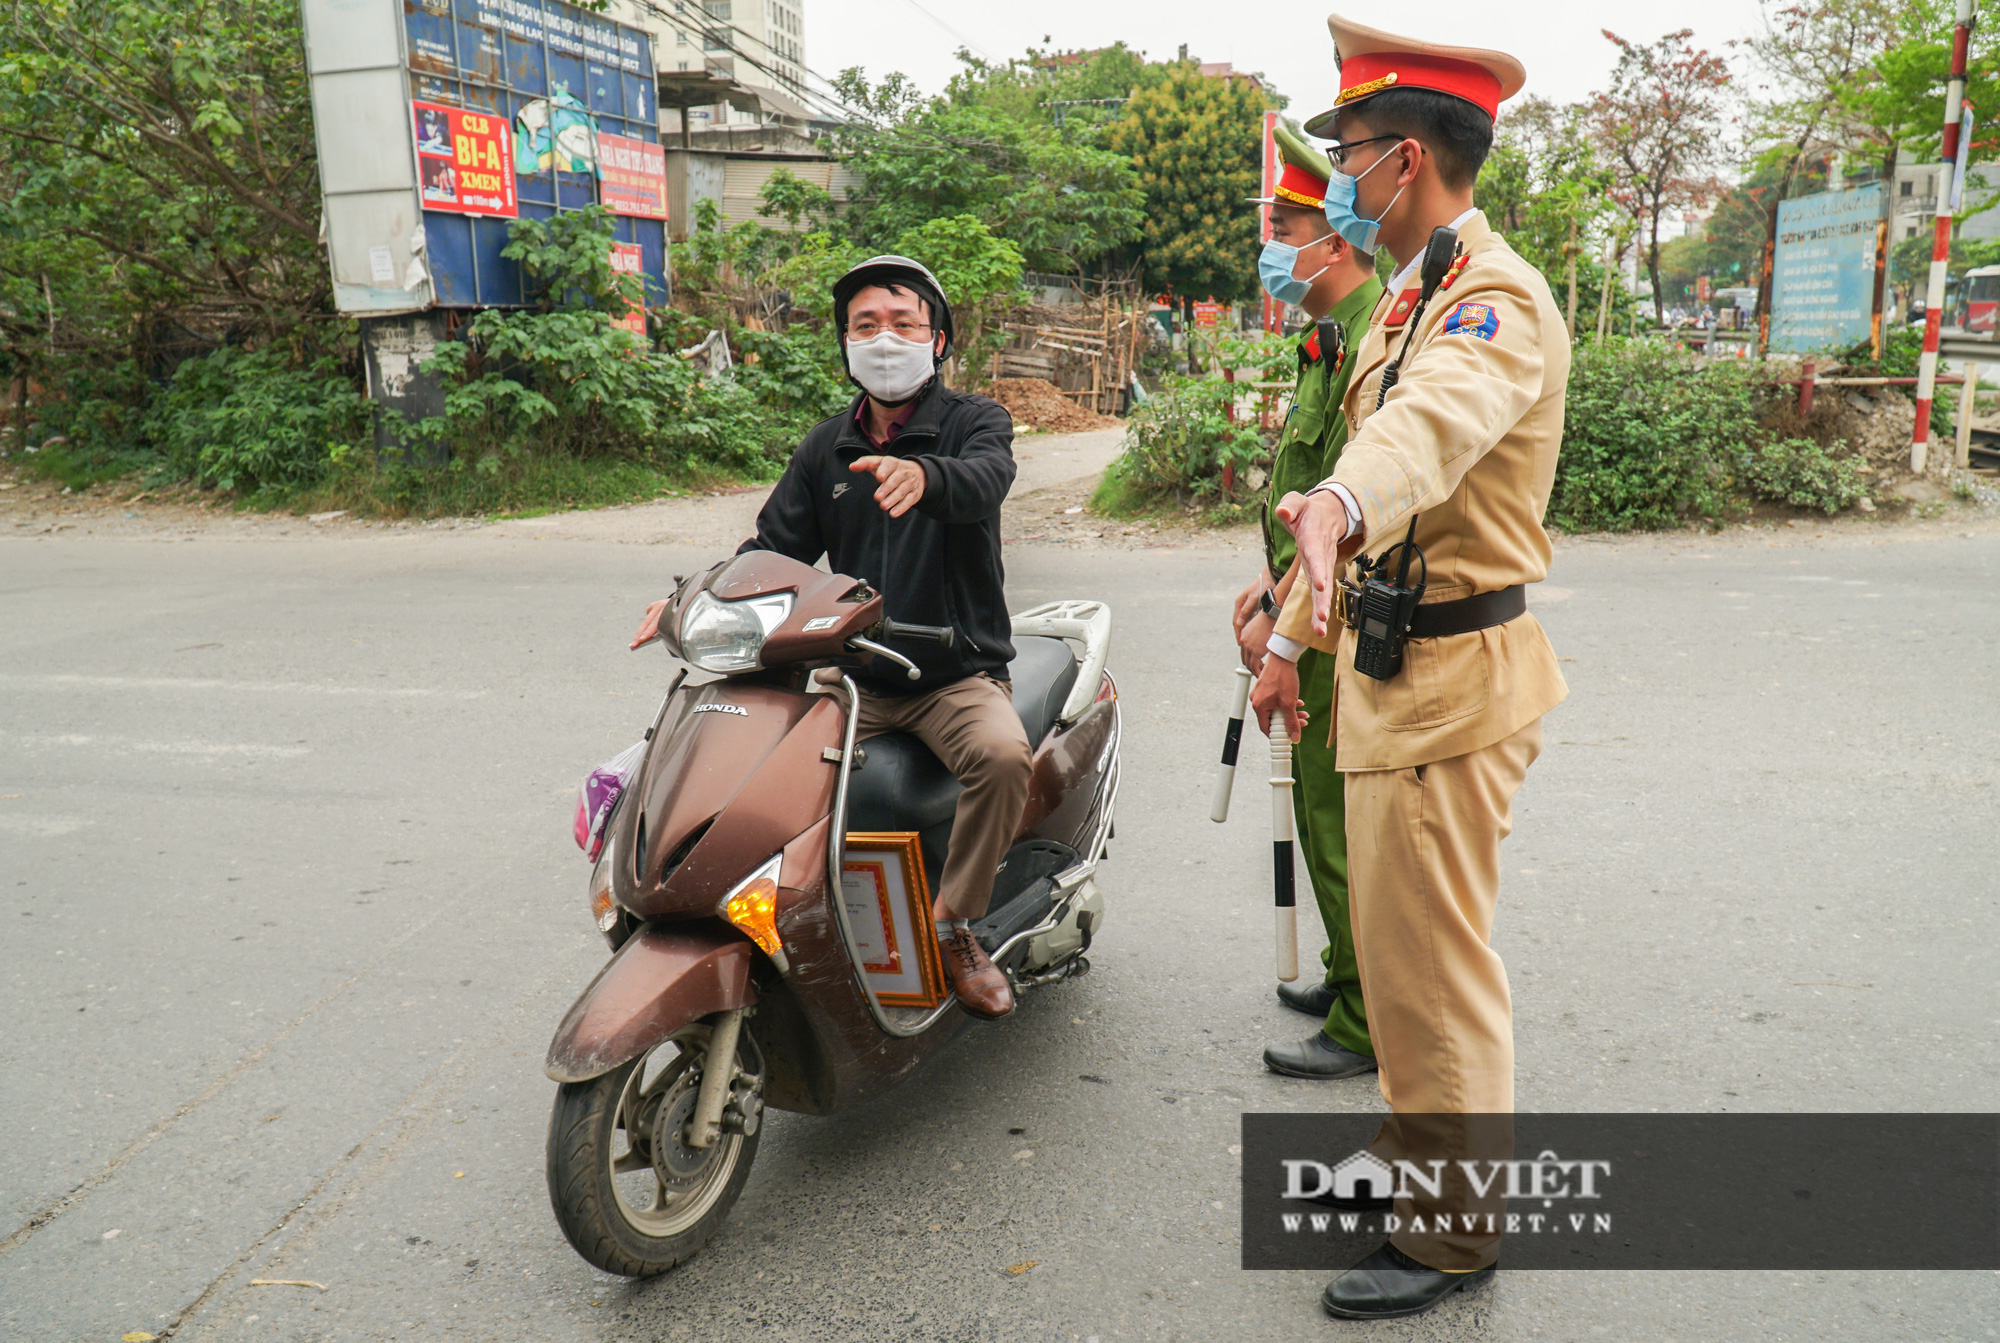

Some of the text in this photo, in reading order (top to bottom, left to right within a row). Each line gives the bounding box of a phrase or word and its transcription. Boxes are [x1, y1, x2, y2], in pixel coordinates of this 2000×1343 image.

[526, 26, 544, 41] LAK
[462, 114, 489, 134] CLB
[455, 134, 501, 170] BI-A
[460, 171, 501, 191] XMEN
[693, 703, 749, 716] HONDA
